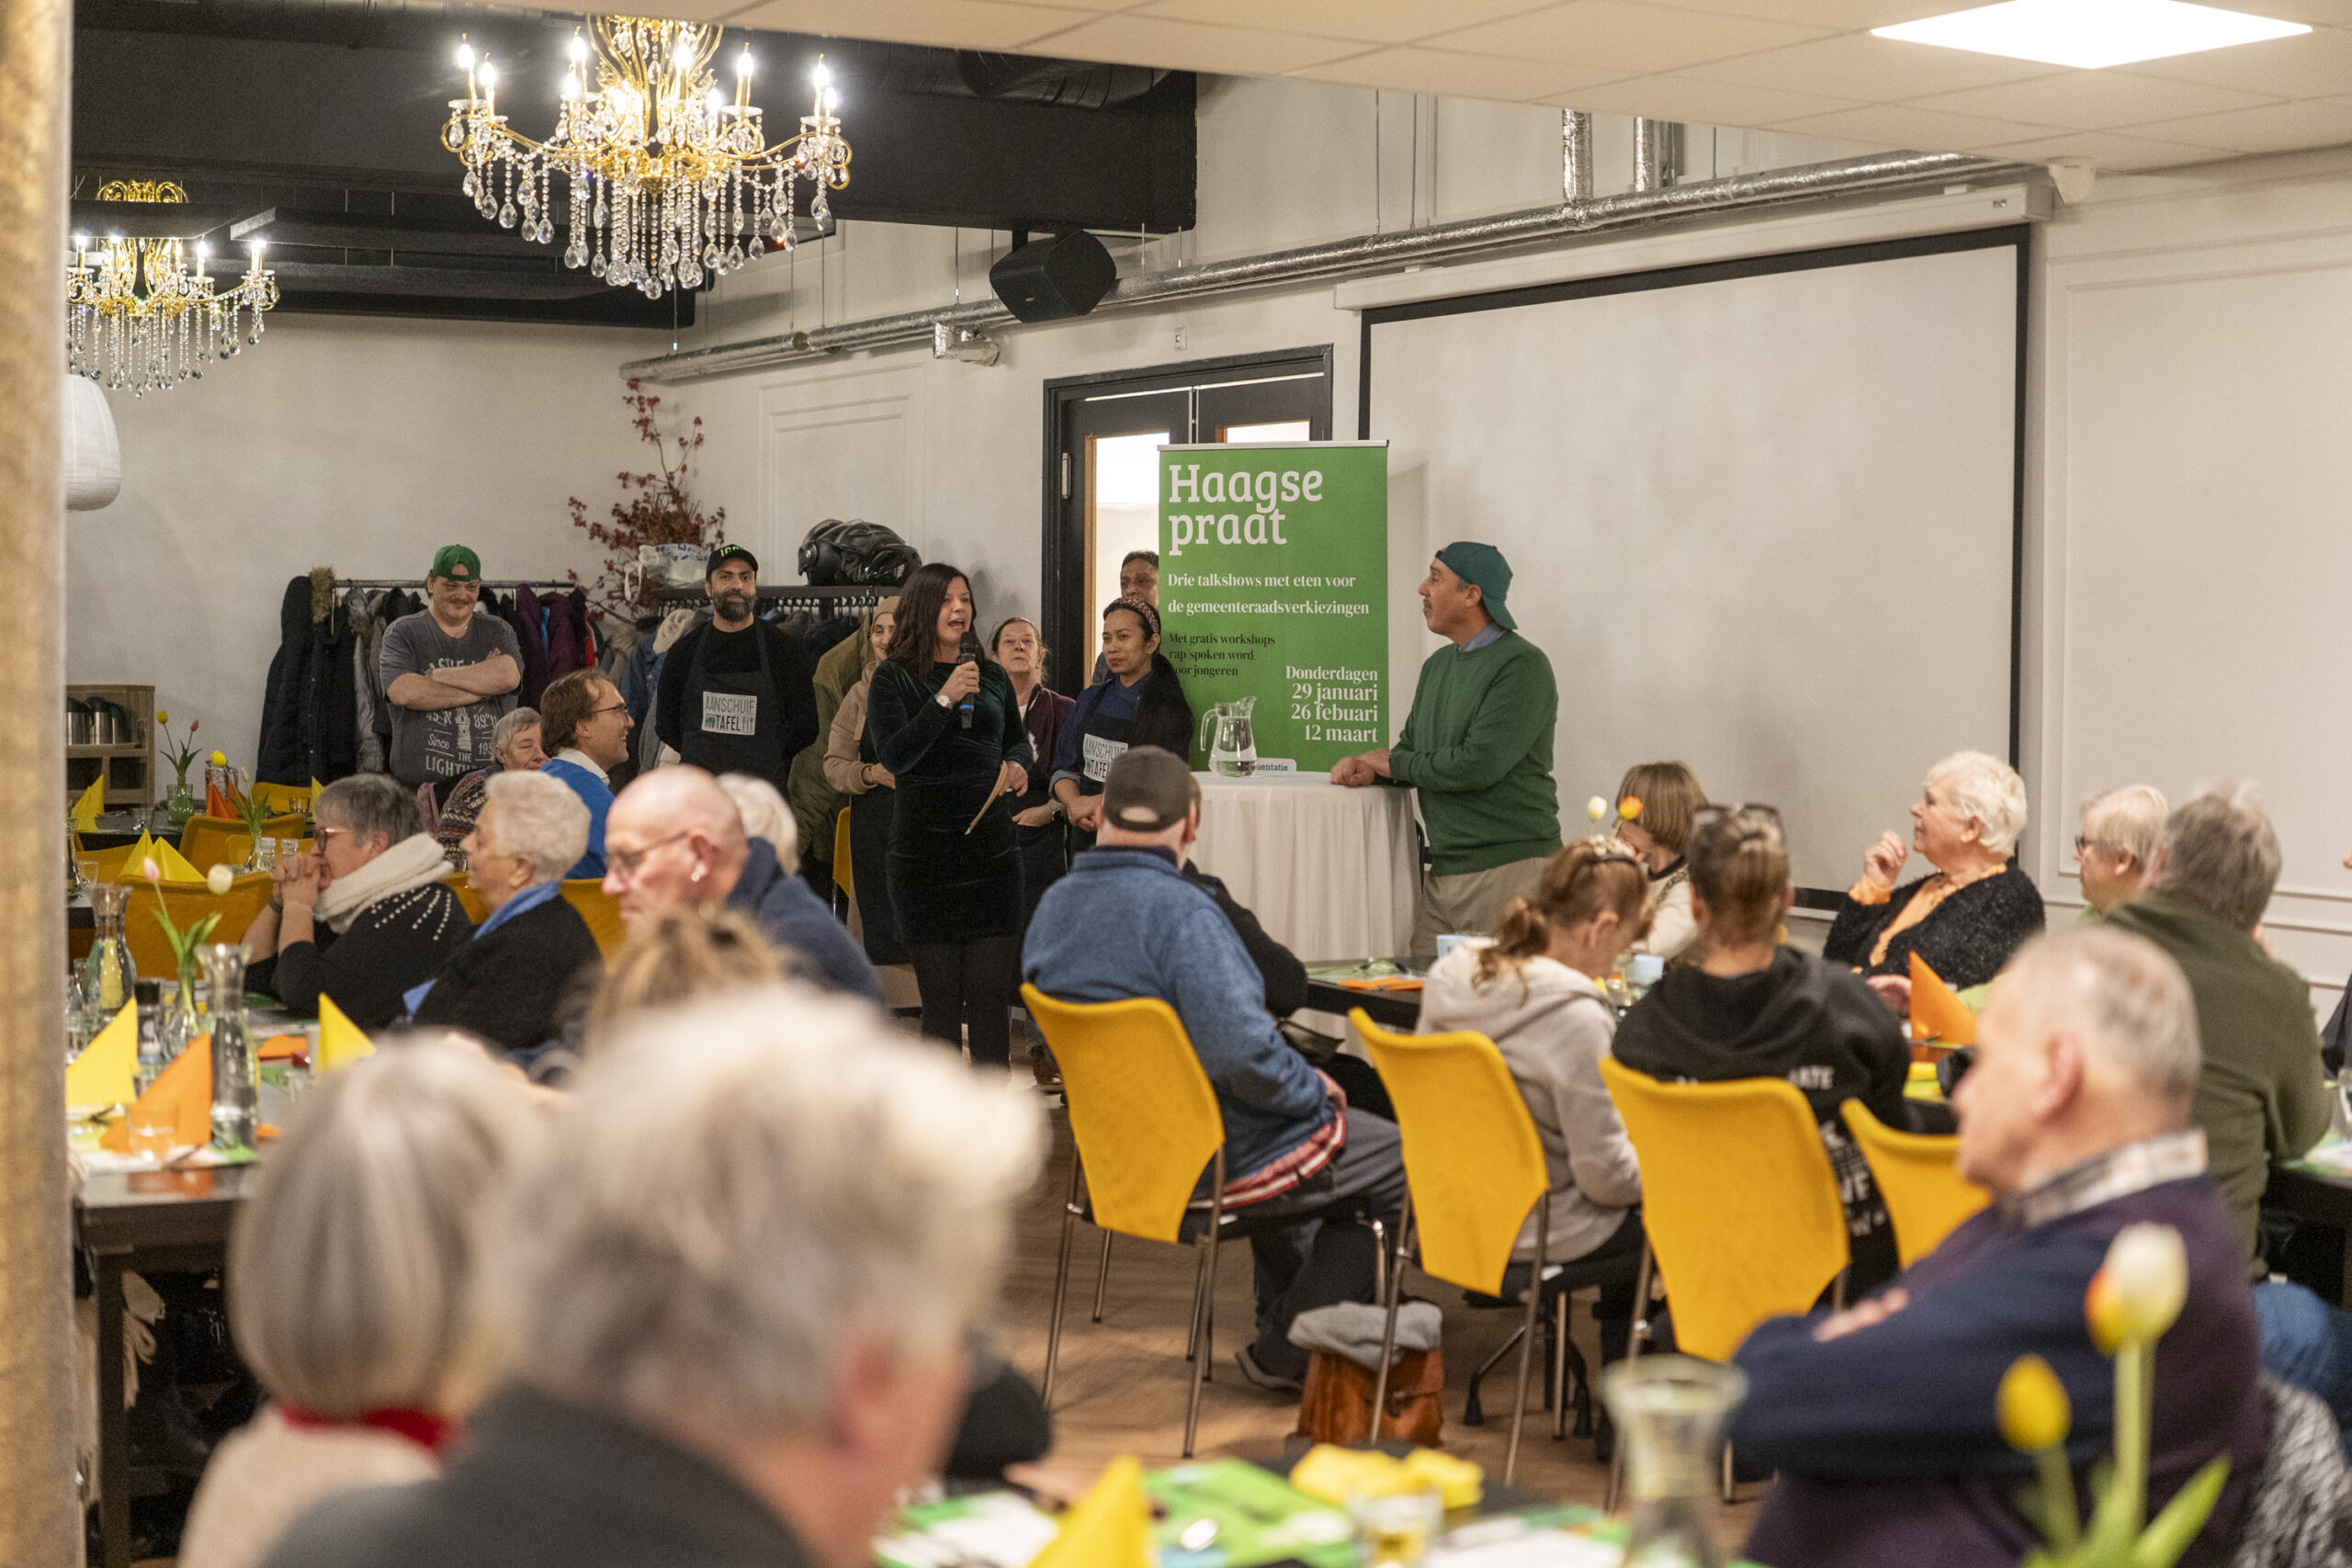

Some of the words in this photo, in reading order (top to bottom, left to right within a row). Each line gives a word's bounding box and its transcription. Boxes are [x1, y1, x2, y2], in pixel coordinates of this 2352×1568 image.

[1169, 464, 1323, 513] Haagse
[1169, 509, 1287, 556] praat
[1168, 573, 1194, 587] Drie
[1197, 573, 1261, 587] talkshows
[1264, 574, 1290, 587] met
[1294, 575, 1322, 587] eten
[1325, 576, 1356, 587] voor
[1168, 600, 1183, 614] de
[1186, 600, 1370, 617] gemeenteraadsverkiezingen
[1169, 634, 1188, 644] Met
[1189, 634, 1218, 647] gratis
[1220, 634, 1276, 647] workshops
[1169, 650, 1187, 661] rap
[1190, 649, 1226, 661] spoken
[1227, 650, 1254, 660] word
[1171, 666, 1193, 676] oor
[1193, 665, 1238, 678] jongeren
[1286, 666, 1378, 684] Donderdagen
[1292, 683, 1313, 699] 29
[1316, 682, 1378, 704] januari
[705, 695, 755, 714] AANSCHUIF
[1291, 704, 1312, 720] 26
[1315, 703, 1378, 722] febuari
[716, 715, 741, 731] TAFEL
[427, 733, 450, 750] Since
[1305, 725, 1322, 741] 12
[1326, 726, 1378, 742] maart
[458, 751, 472, 762] THE
[1256, 763, 1289, 772] sentatie
